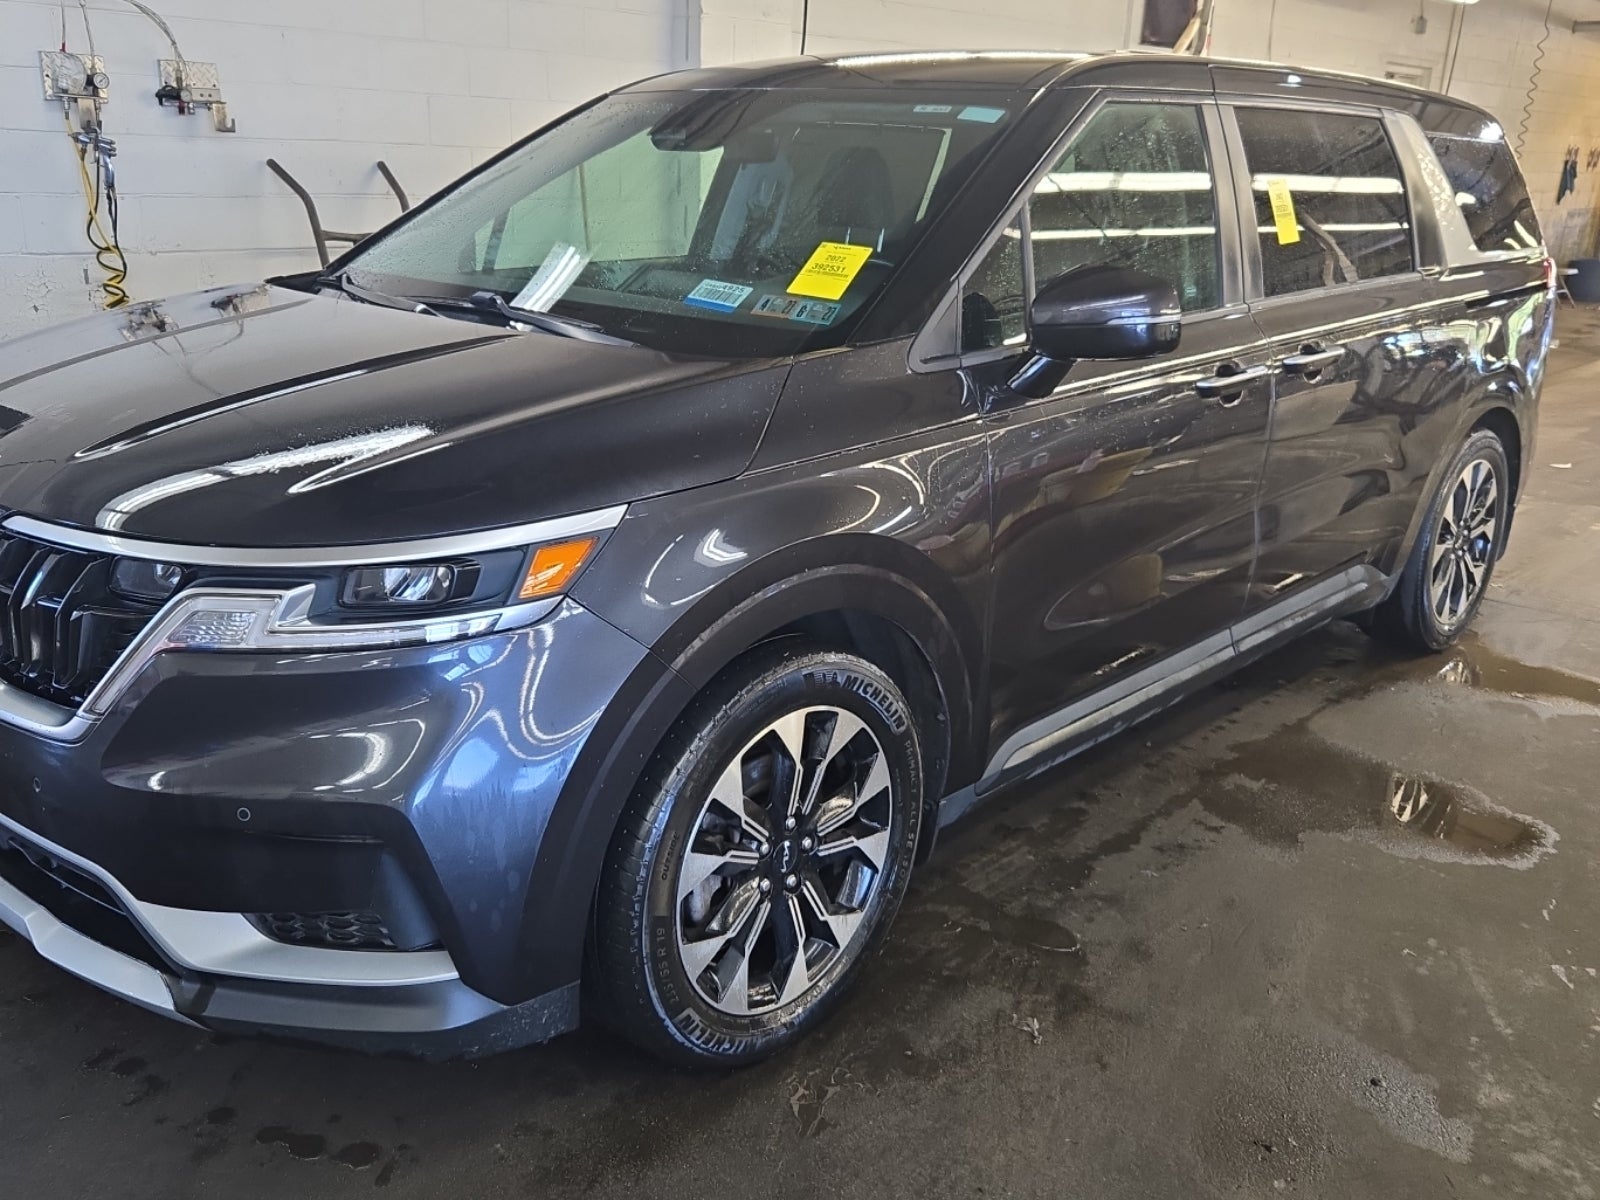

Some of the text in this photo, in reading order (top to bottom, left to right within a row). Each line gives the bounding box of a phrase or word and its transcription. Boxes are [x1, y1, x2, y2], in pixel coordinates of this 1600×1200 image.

[841, 674, 906, 730] MICHELIN
[908, 801, 918, 827] ALL
[661, 831, 680, 881] OUTSIDE
[655, 927, 666, 942] 19
